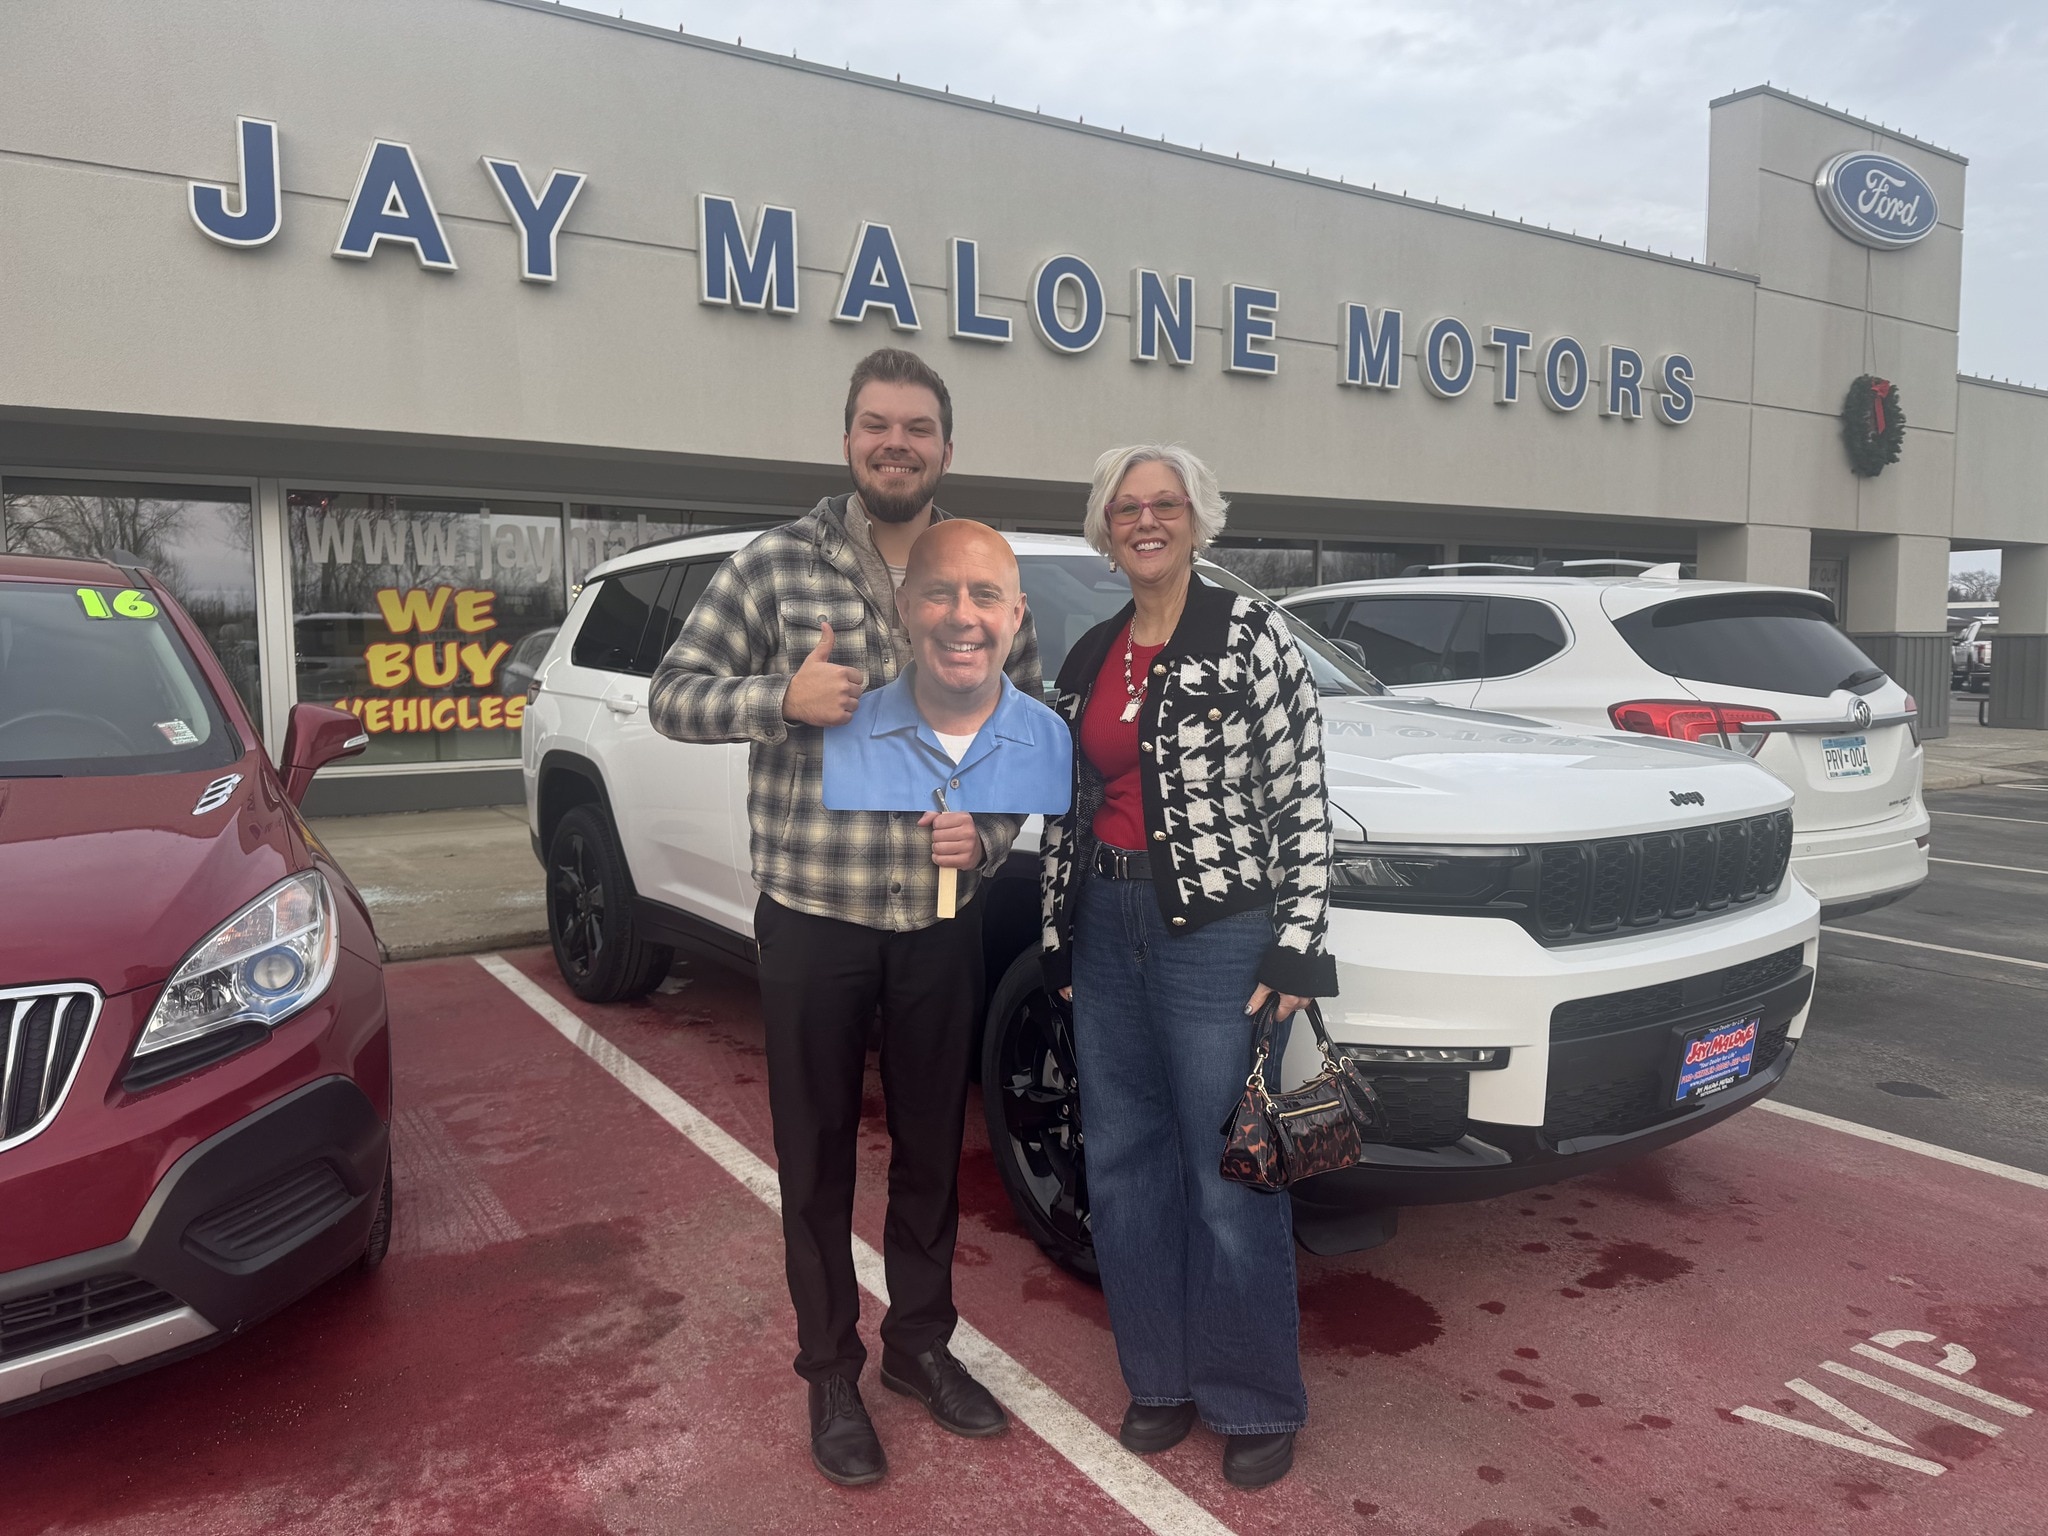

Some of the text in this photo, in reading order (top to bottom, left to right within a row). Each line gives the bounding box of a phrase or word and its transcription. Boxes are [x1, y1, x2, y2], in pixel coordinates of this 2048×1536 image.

[1858, 169, 1920, 227] Ford
[187, 114, 1697, 426] JAY MALONE MOTORS
[76, 588, 159, 620] 16
[375, 585, 500, 636] WE
[363, 639, 513, 690] BUY
[1825, 746, 1869, 771] PRV 004
[1669, 791, 1704, 806] Jeep
[1685, 1022, 1755, 1065] JAY MALONE
[1731, 1329, 2035, 1477] VIP
